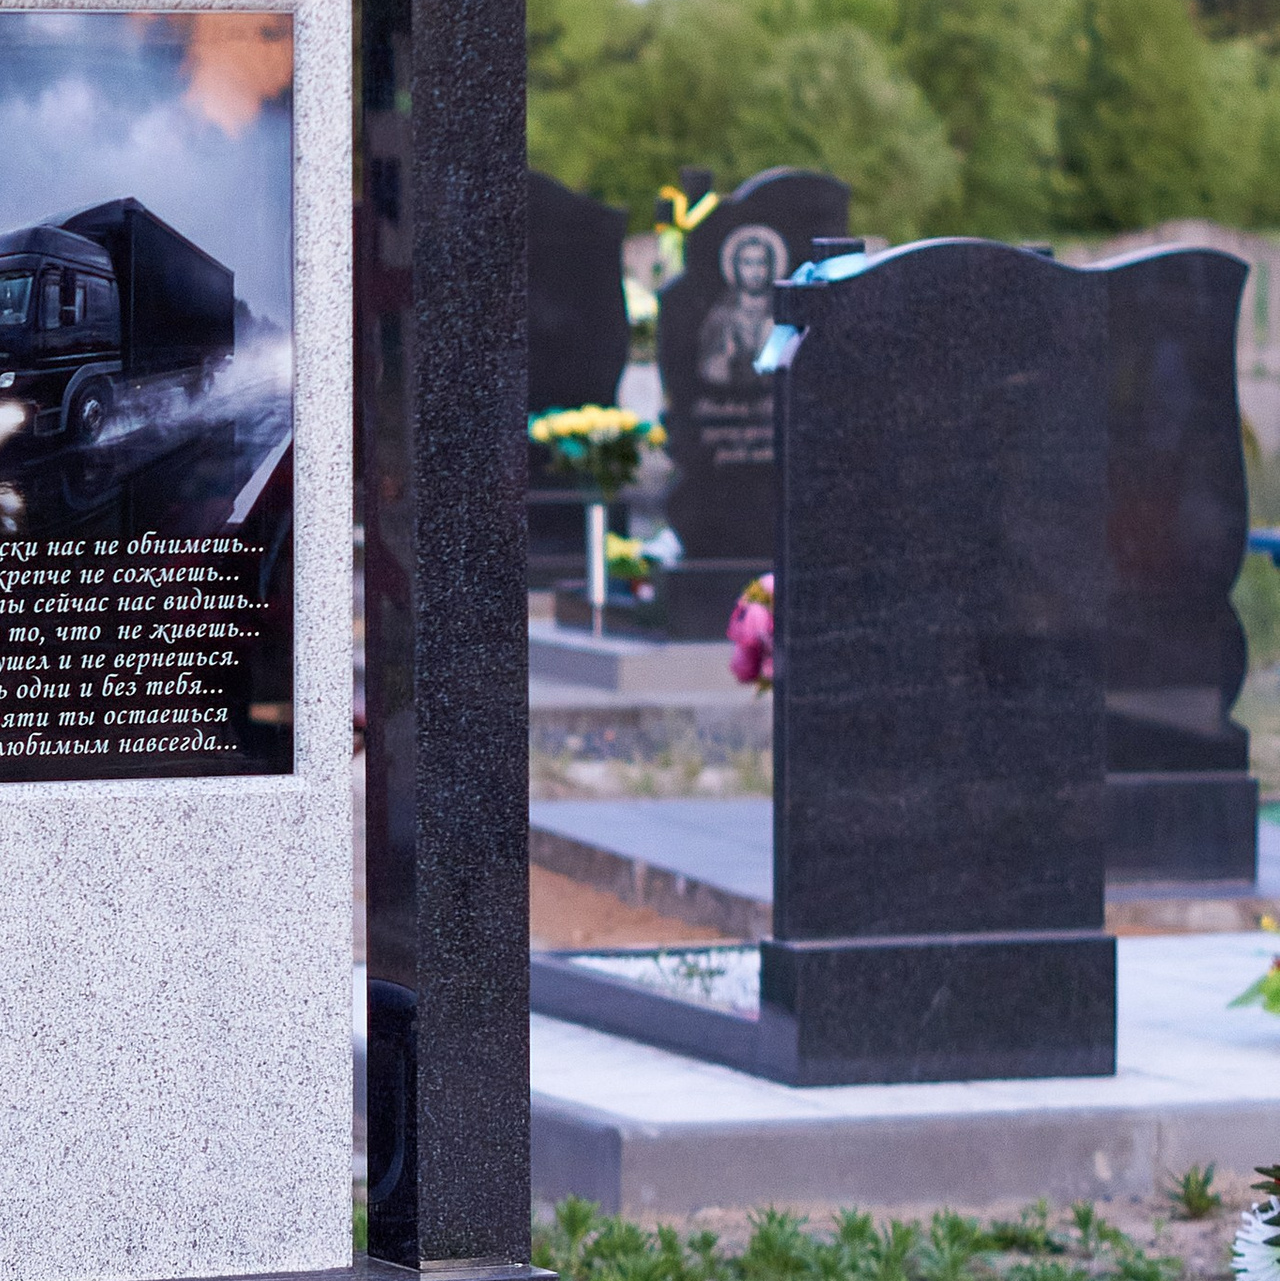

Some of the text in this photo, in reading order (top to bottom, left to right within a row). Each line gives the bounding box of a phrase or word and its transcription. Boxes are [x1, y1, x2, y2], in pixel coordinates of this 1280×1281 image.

[47, 540, 87, 557] нас
[94, 539, 120, 556] не
[126, 530, 264, 555] обнимешь...
[79, 568, 106, 585] не
[112, 566, 239, 589] сожмешь...
[33, 592, 110, 614] сейчас
[117, 595, 157, 612] нас
[163, 586, 269, 611] видишь...
[8, 626, 46, 646] то,
[55, 625, 102, 642] что
[117, 624, 143, 640] не
[148, 622, 260, 645] живешь...
[58, 654, 72, 670] и
[80, 653, 106, 669] не
[113, 650, 239, 676] вернешься.
[16, 675, 71, 699] одни
[79, 682, 93, 698] и
[101, 673, 137, 697] без
[145, 671, 223, 696] тебя...
[58, 711, 95, 727] ты
[103, 707, 229, 726] остаешься
[118, 727, 238, 754] навсегда...
